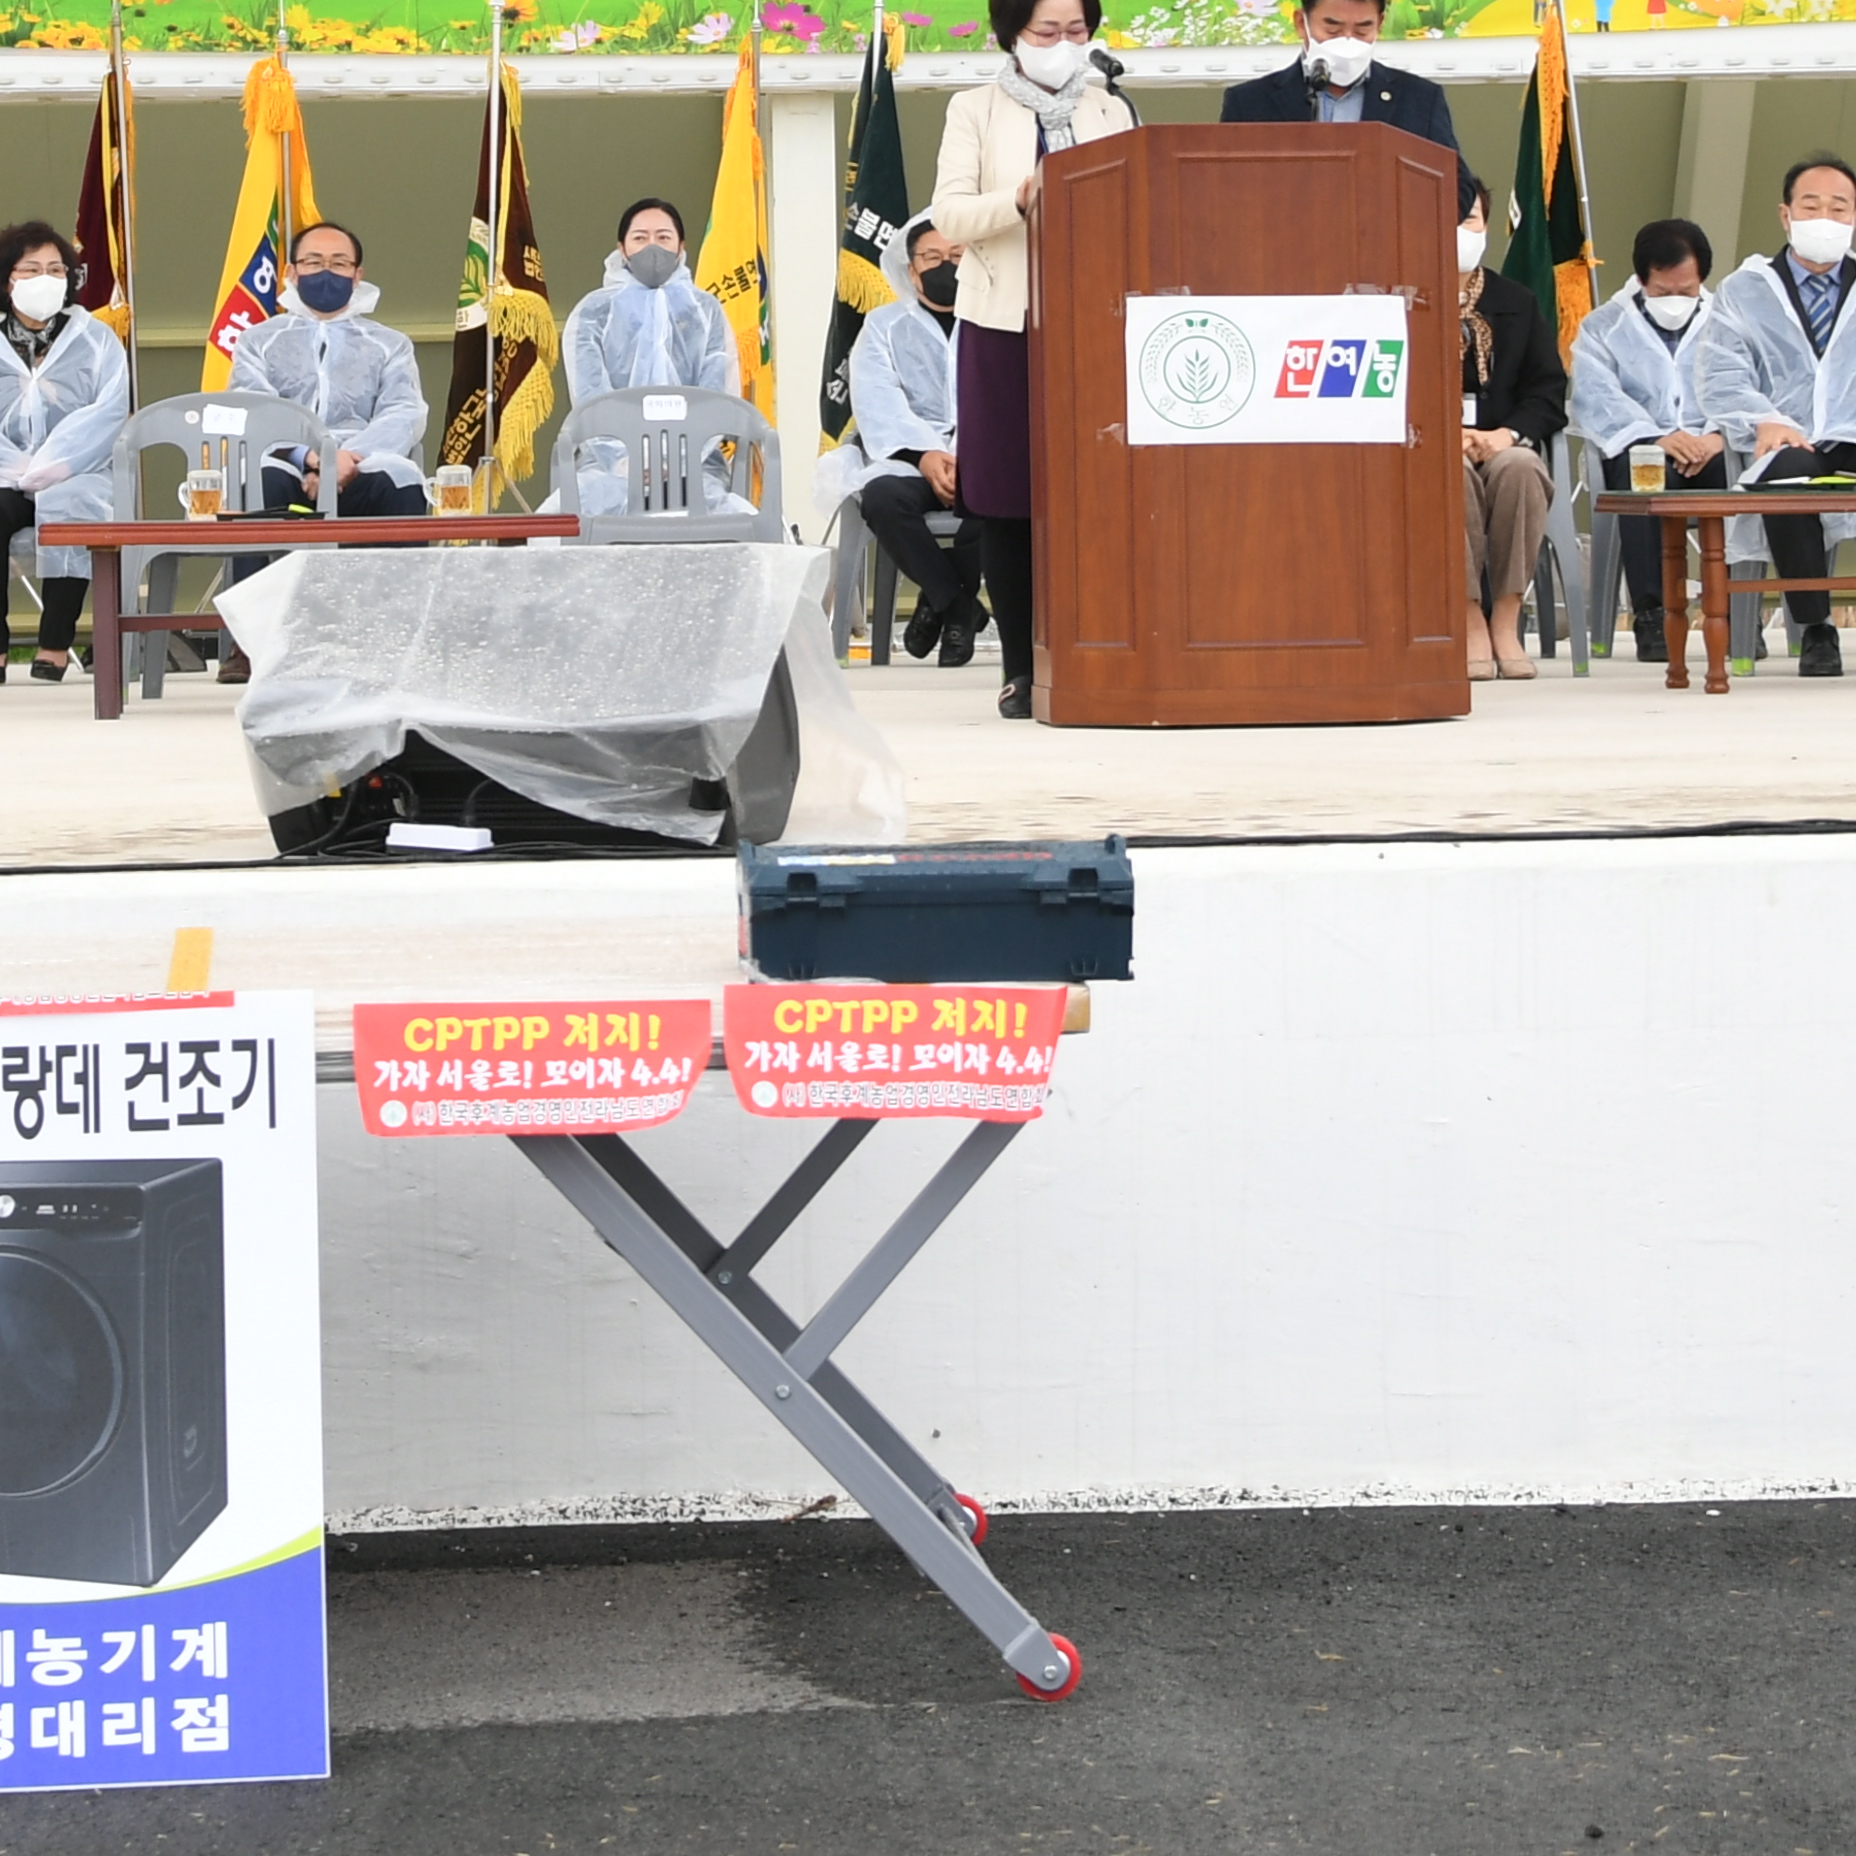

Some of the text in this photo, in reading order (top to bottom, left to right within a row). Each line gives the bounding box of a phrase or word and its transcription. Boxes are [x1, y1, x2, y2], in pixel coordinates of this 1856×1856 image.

[1284, 341, 1397, 394] 한여농
[404, 1012, 661, 1053] CPTPP 저지!
[773, 996, 1028, 1040] CPTPP 저지!
[373, 1057, 693, 1092] 가자 서울로! 모이자 4.4!
[743, 1040, 1055, 1075] 가자 서울로! 모이자 4.4!
[124, 1037, 278, 1133] 건조기
